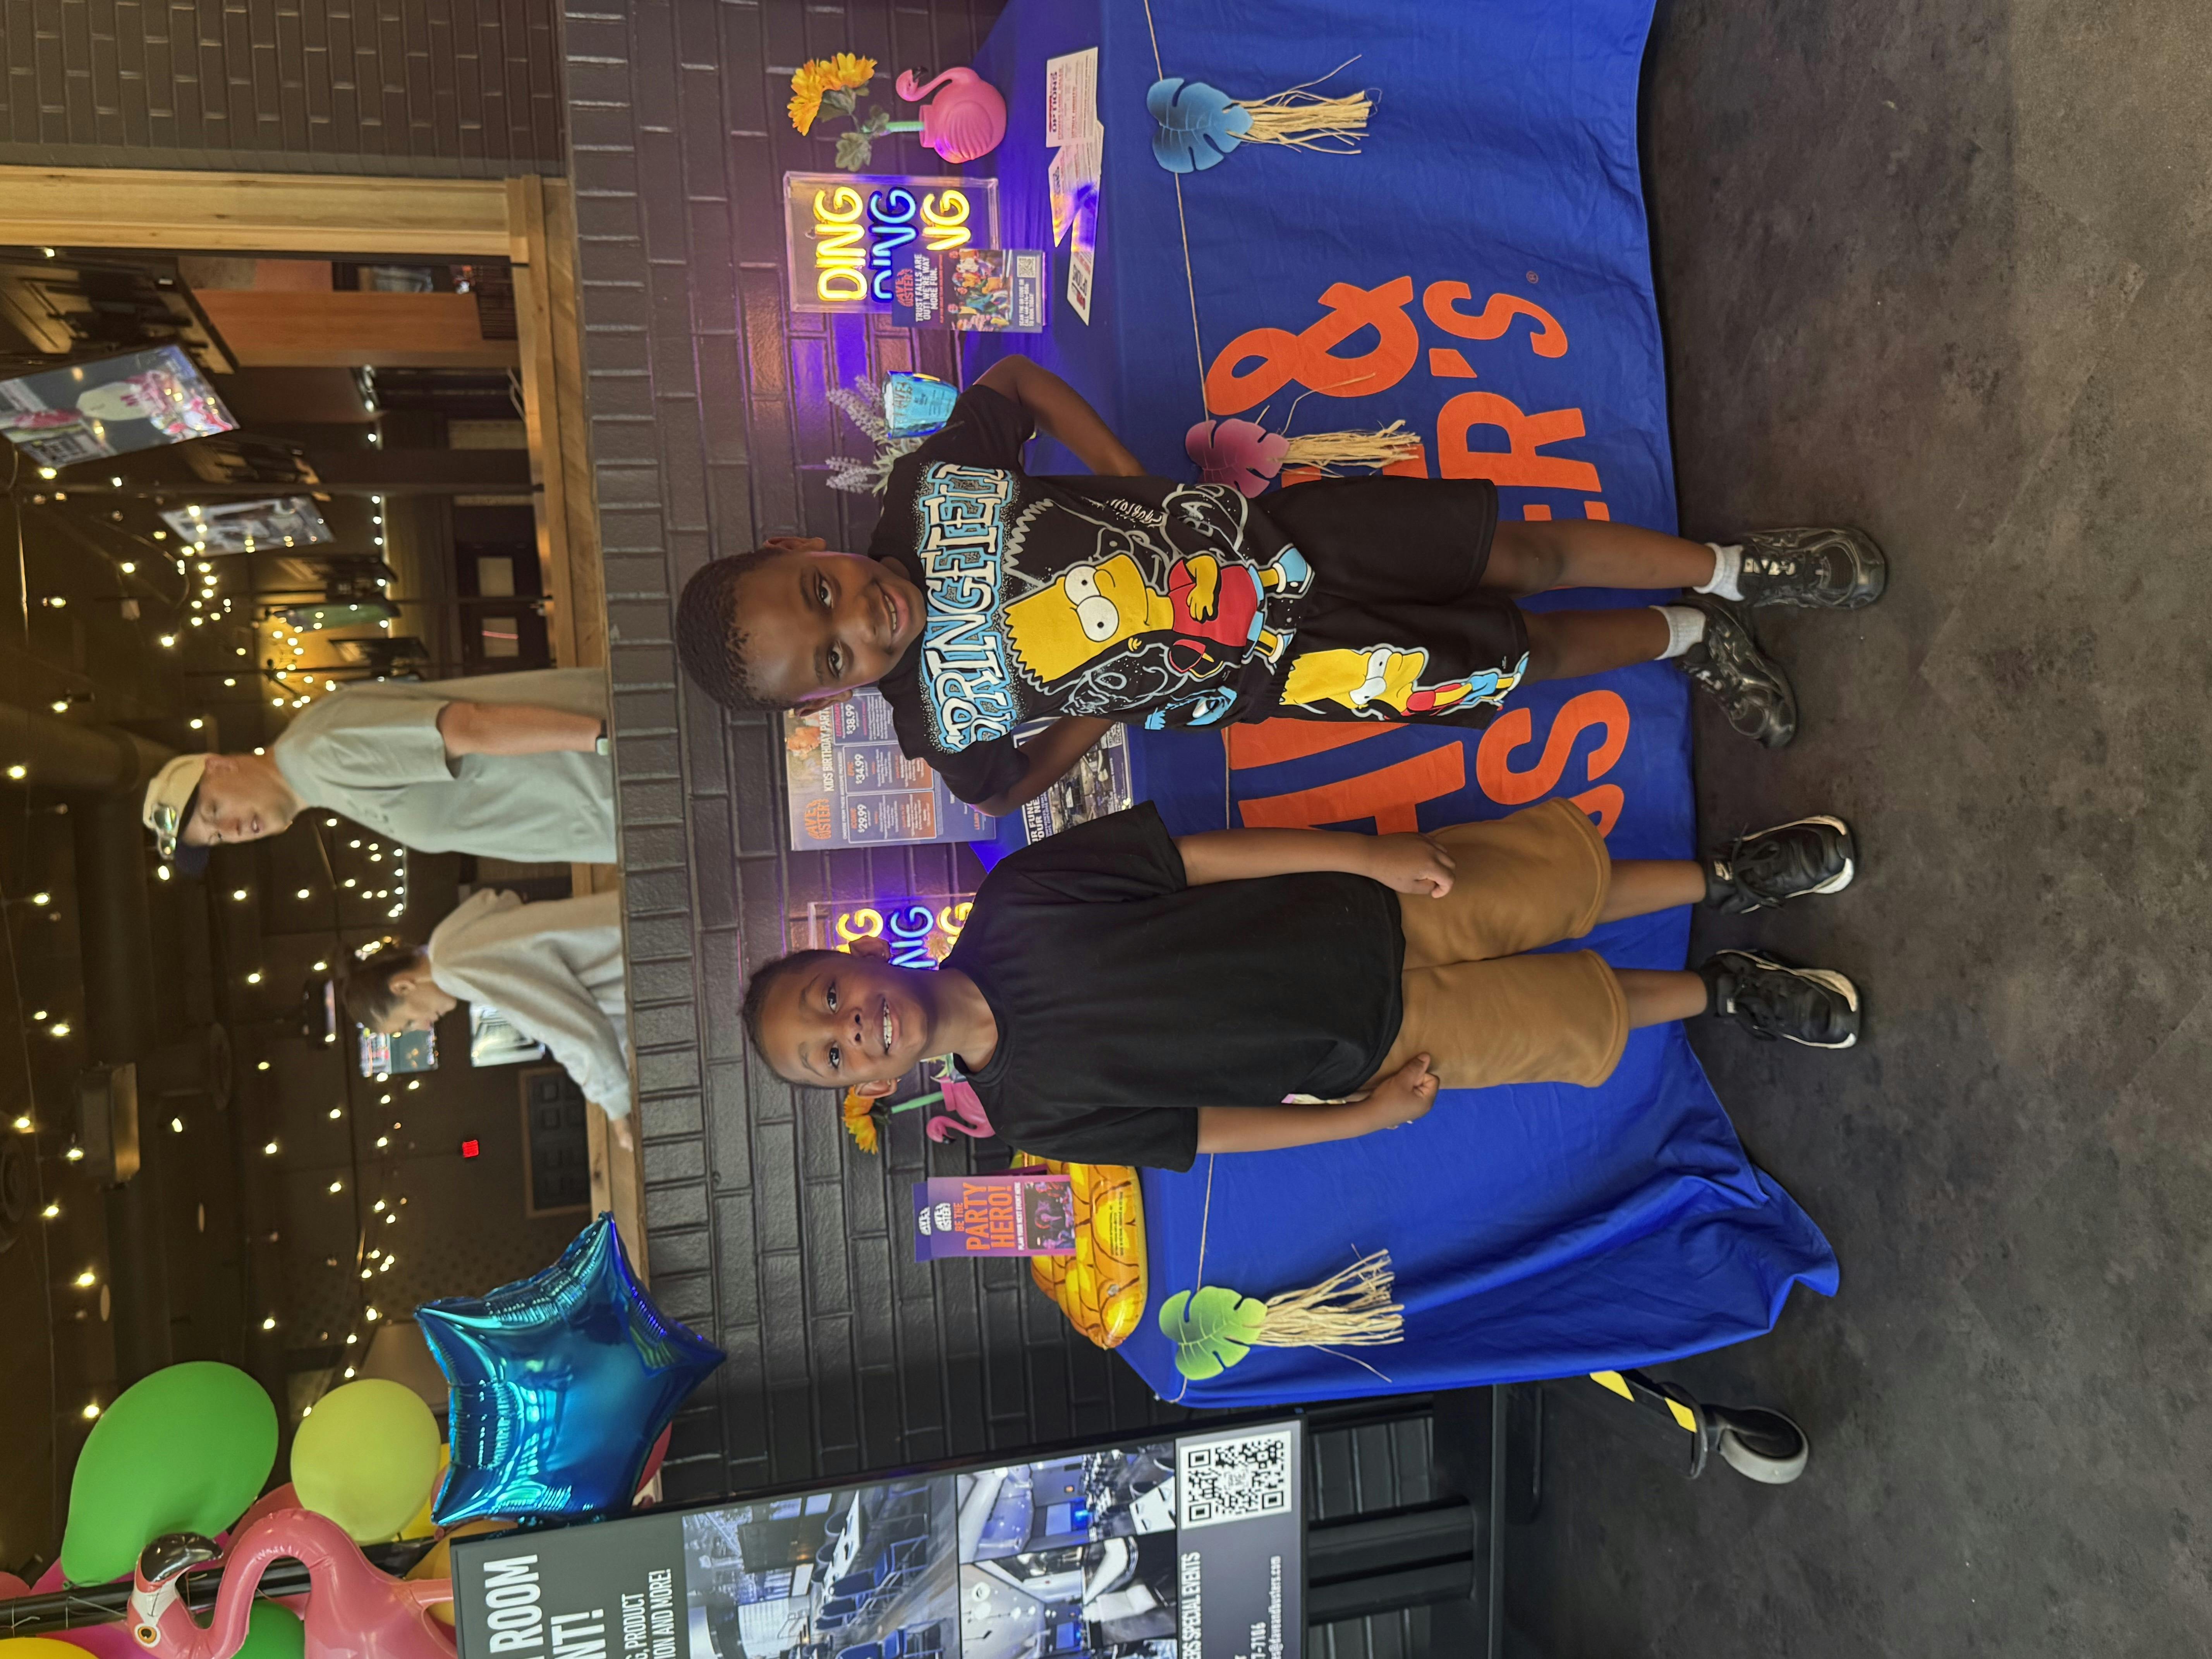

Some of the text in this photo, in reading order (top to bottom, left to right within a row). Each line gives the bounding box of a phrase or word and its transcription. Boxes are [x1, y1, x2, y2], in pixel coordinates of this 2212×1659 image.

[920, 189, 972, 251] NG
[813, 187, 867, 301] DING
[914, 254, 924, 322] TRUST FALLS ARE
[922, 256, 931, 320] OUT! WE'RE WAY
[929, 268, 938, 310] MORE FUN.
[1204, 275, 1419, 416] &
[845, 704, 856, 735] $38.99
[820, 732, 833, 772] BIRTHDAY
[854, 754, 866, 784] $34.99
[823, 773, 835, 792] KIDS
[857, 804, 868, 833] $29.99
[1036, 816, 1045, 841] OUR
[953, 1202, 965, 1231] BE THE
[963, 1182, 991, 1250] PARTY
[988, 1185, 1015, 1248] HERO!
[648, 1568, 673, 1610] MORE!
[1181, 1552, 1201, 1596] EVENTS
[483, 1554, 543, 1653] ROOM
[621, 1593, 647, 1649] PRODUCT
[651, 1609, 675, 1635] AND
[1181, 1595, 1201, 1641] SPECIAL
